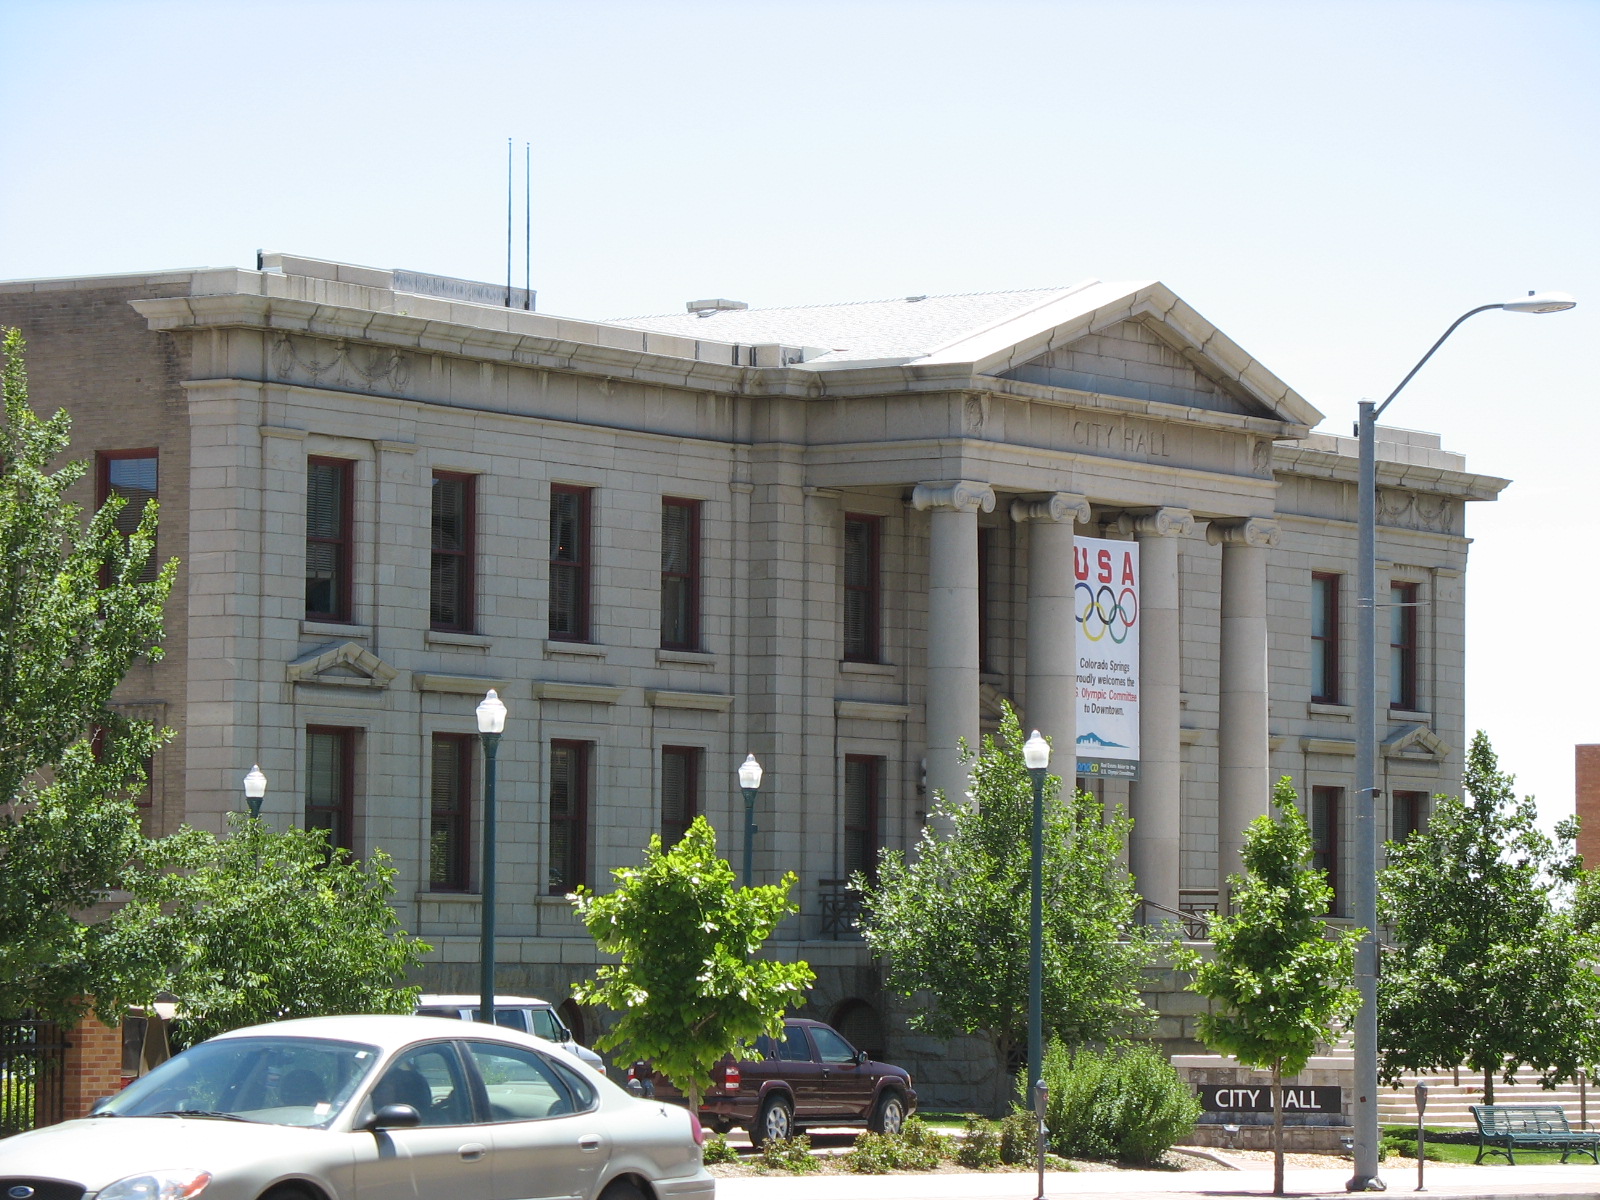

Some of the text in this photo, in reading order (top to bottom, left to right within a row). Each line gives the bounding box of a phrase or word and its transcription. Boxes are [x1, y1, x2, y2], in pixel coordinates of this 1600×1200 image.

[1073, 421, 1169, 457] CITY HALL
[1074, 546, 1135, 586] USA
[1080, 657, 1130, 674] Colorado Springs
[1076, 673, 1135, 687] roudly welcomes the
[1081, 687, 1107, 701] Olympic
[1109, 690, 1137, 702] Committee
[1084, 703, 1091, 713] to
[1215, 1089, 1260, 1108] CITY
